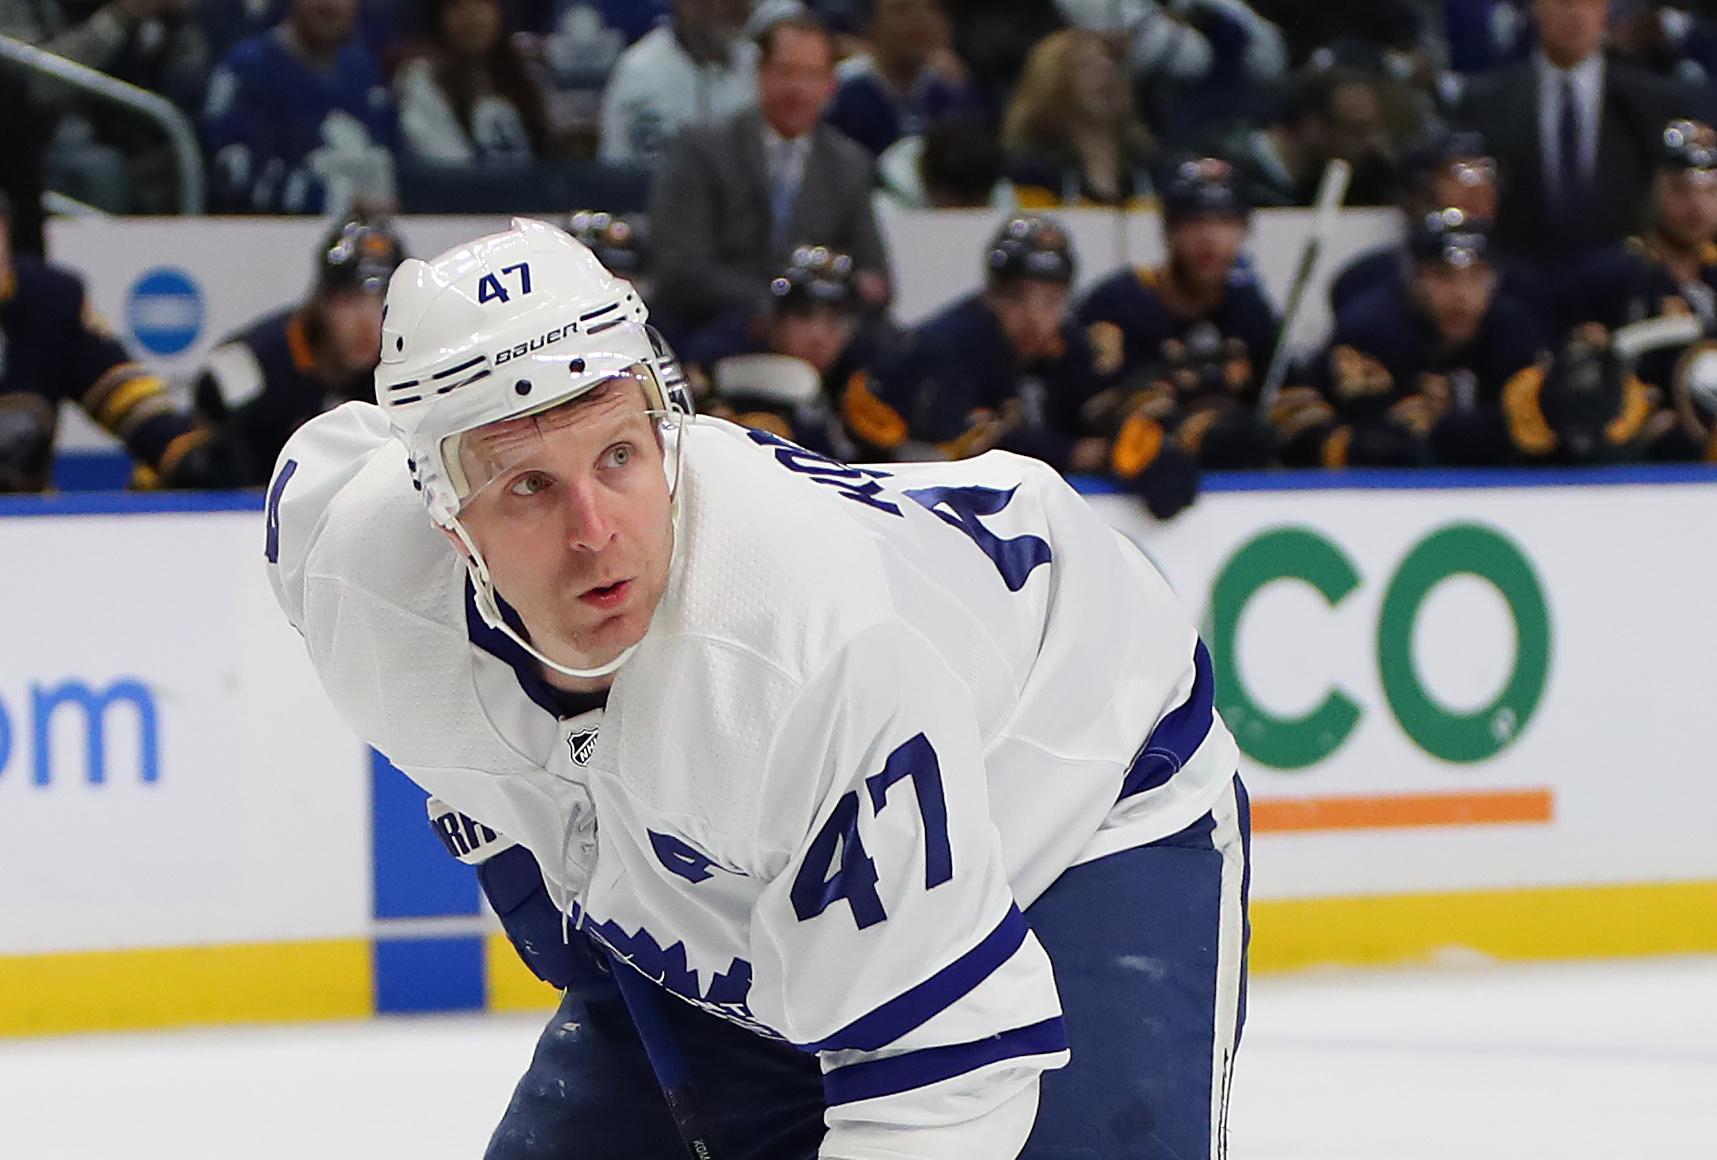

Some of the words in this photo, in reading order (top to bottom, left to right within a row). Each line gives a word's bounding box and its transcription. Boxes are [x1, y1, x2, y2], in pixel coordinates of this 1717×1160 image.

[478, 262, 532, 305] 47
[1204, 520, 1553, 771] CO
[0, 674, 161, 786] m
[789, 730, 953, 931] 47
